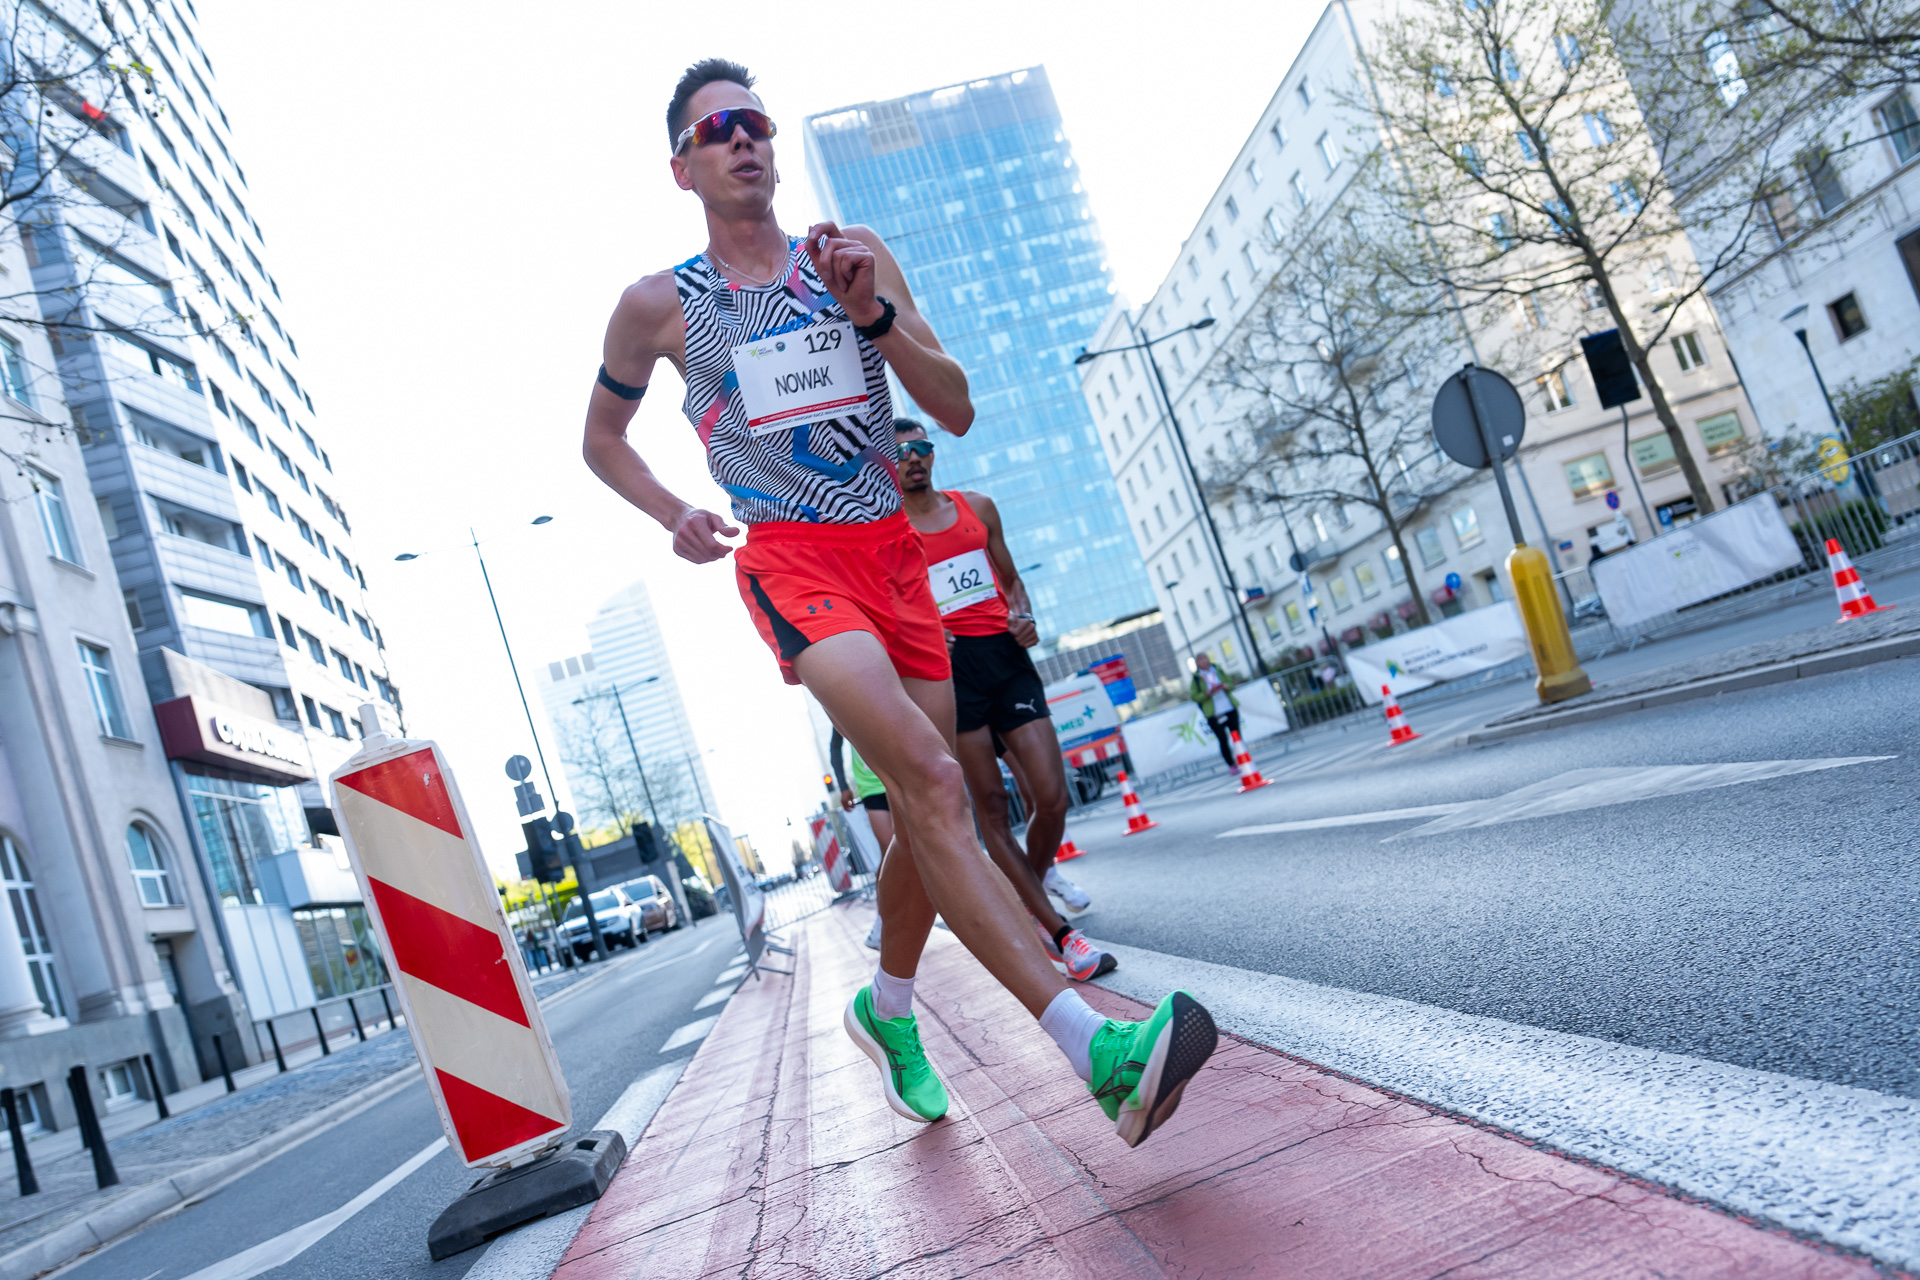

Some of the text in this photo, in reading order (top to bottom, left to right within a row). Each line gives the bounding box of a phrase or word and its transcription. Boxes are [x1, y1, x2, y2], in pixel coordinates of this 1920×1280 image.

[764, 312, 814, 338] TERREX
[804, 329, 842, 354] 129
[775, 365, 833, 396] NOWAK
[948, 568, 983, 594] 162
